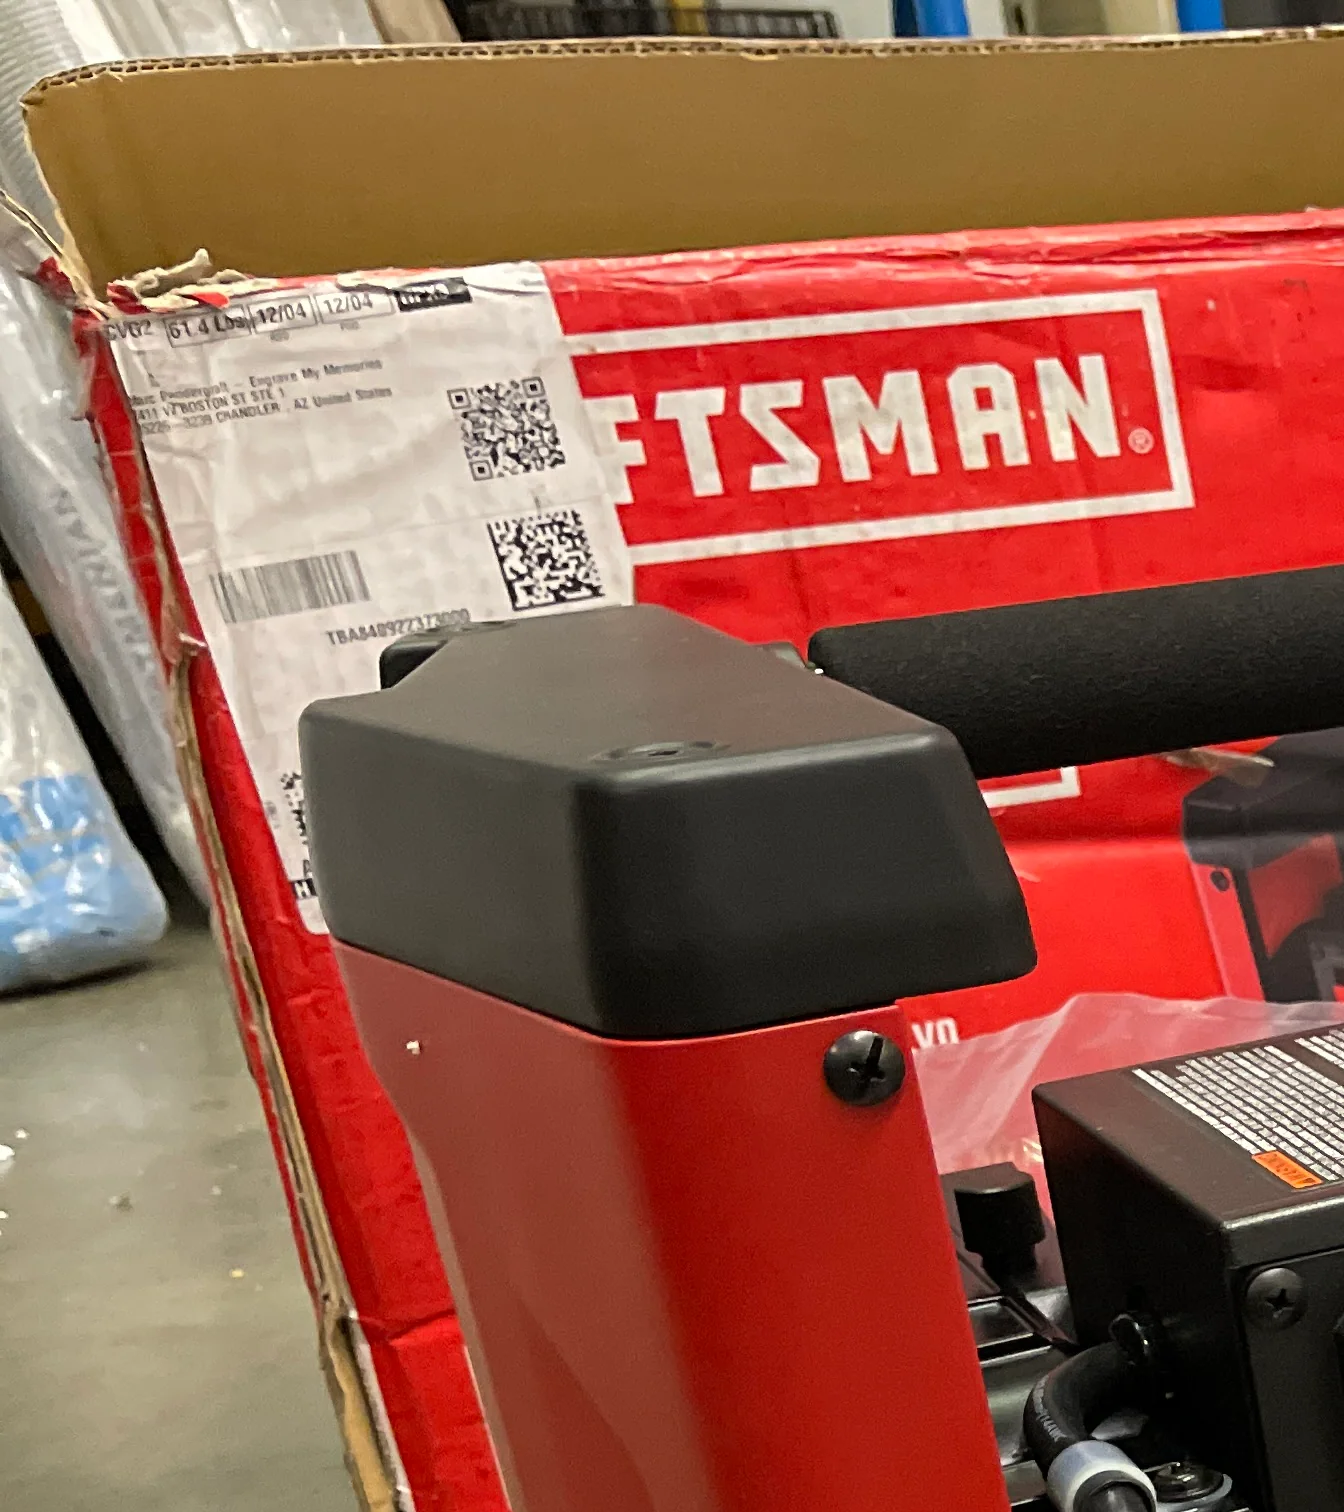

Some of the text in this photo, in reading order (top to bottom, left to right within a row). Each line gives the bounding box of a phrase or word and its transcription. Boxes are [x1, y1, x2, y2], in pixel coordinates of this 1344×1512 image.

[256, 302, 306, 324] 12/04
[323, 292, 373, 315] 12/04
[181, 395, 229, 415] BOSTON
[231, 391, 247, 406] ST
[250, 388, 274, 402] STE
[216, 401, 281, 423] CHANDLER
